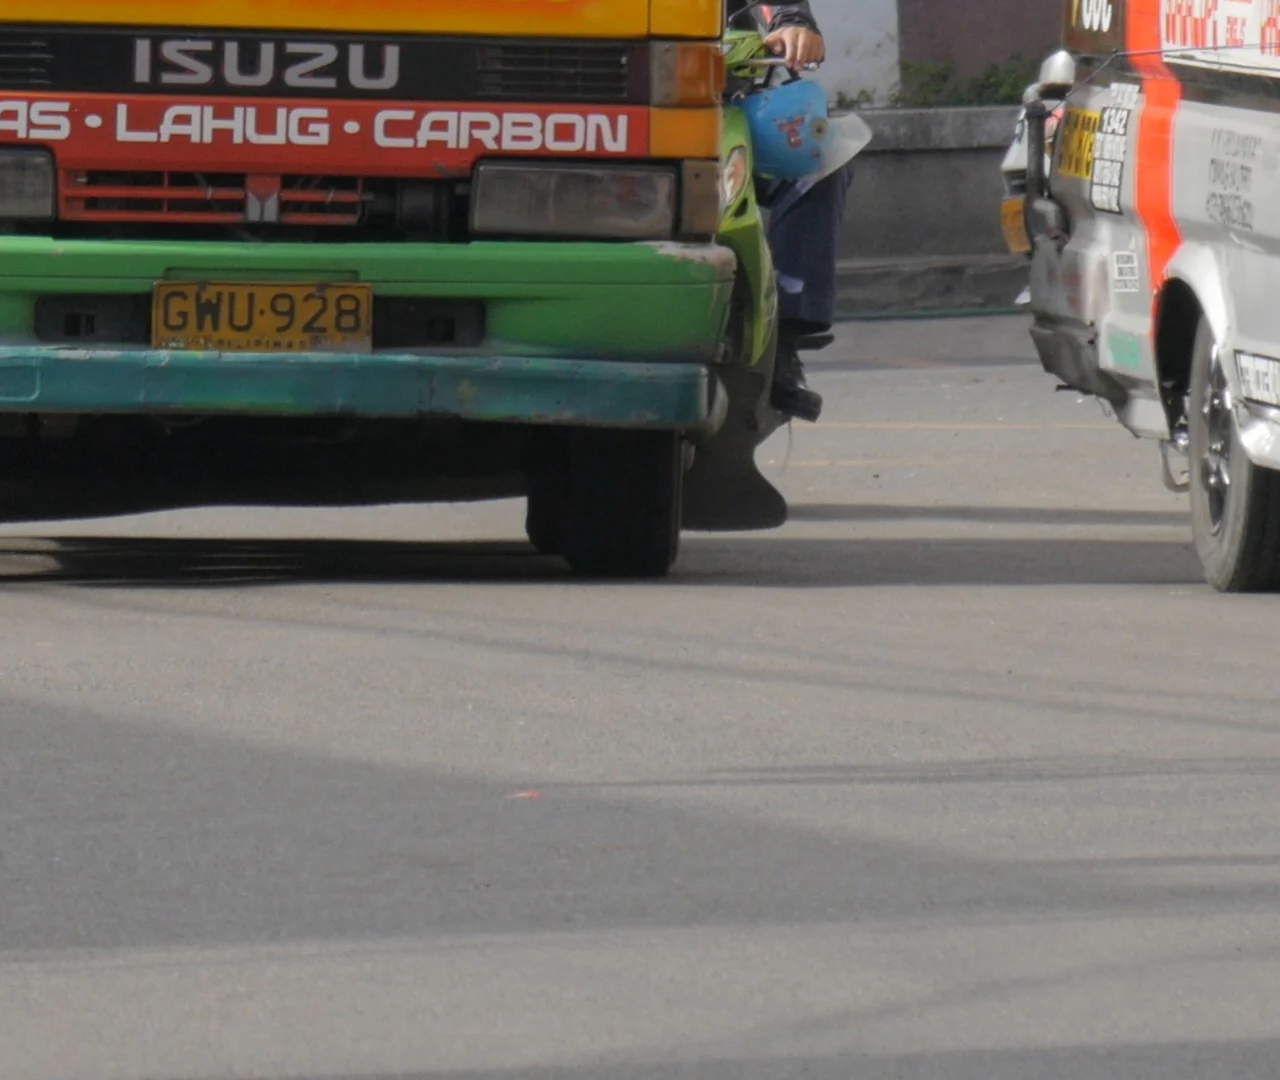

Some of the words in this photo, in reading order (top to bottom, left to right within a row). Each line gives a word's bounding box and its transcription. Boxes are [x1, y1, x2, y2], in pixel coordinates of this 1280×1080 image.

[134, 38, 400, 90] ISUZU
[116, 103, 330, 147] LAHUG
[373, 109, 628, 153] CARBON
